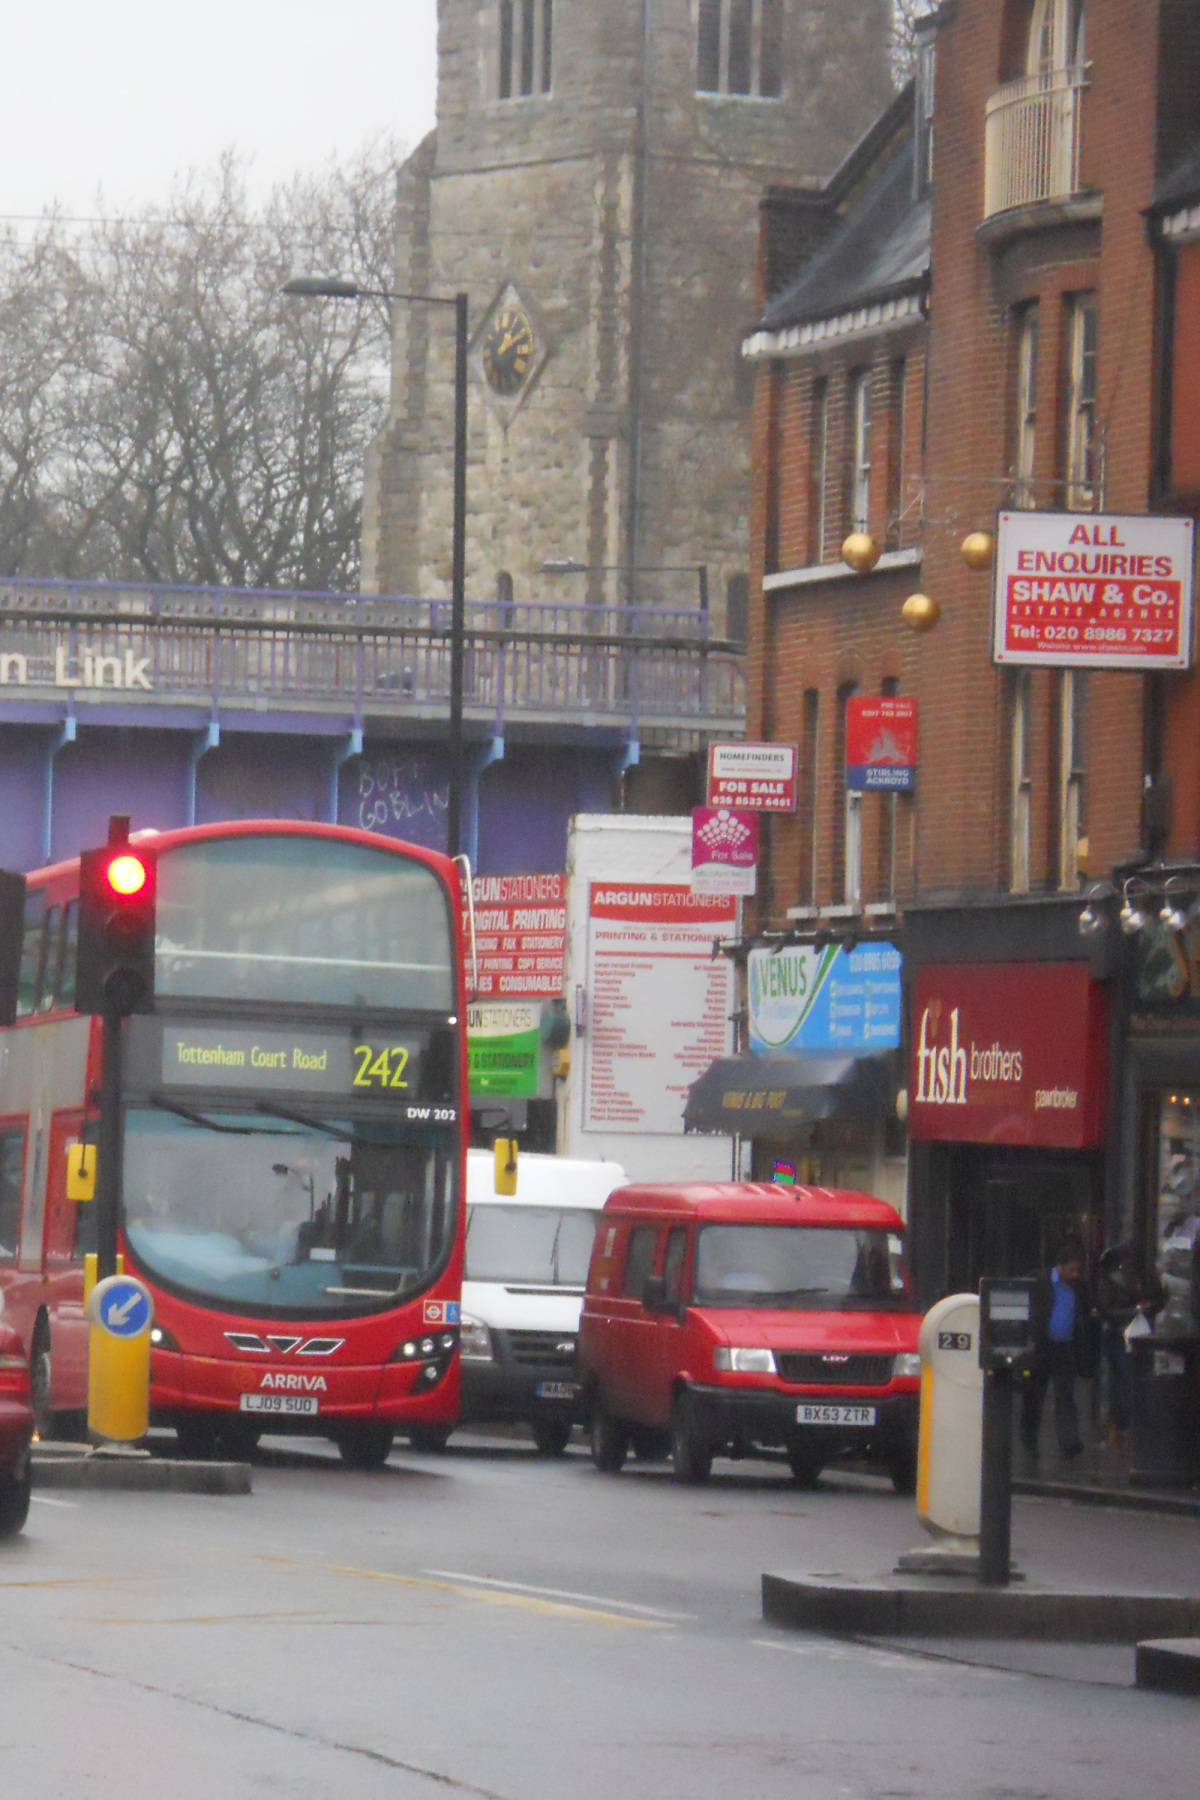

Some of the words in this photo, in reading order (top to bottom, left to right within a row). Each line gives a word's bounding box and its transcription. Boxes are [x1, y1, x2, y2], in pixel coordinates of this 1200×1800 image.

[1068, 524, 1125, 547] ALL
[1017, 550, 1174, 577] ENQUIRIES
[1013, 580, 1095, 603] SHAW
[1102, 584, 1124, 604] &
[1132, 585, 1175, 606] Co.
[1011, 625, 1040, 638] Tel:
[1044, 627, 1079, 640] 020
[1132, 629, 1175, 643] 7327
[55, 646, 153, 690] Link
[719, 752, 785, 762] HOMEFINDERS
[719, 781, 747, 793] FOR
[750, 782, 784, 794] SALE
[711, 851, 728, 860] For
[731, 851, 753, 860] Sale
[513, 909, 566, 930] PRINTING
[595, 931, 647, 940] PRINTING
[661, 933, 729, 942] STATIONERY
[500, 975, 562, 991] CONSUMABLES
[760, 955, 807, 996] VENUS
[468, 1009, 531, 1028] UNSTATIONERS
[177, 1042, 244, 1066] Tottenham
[251, 1046, 286, 1068] Court
[292, 1048, 326, 1070] Road
[353, 1046, 409, 1088] 242
[915, 1007, 967, 1104] fish
[971, 1041, 1022, 1081] brothers
[1035, 1086, 1078, 1110] pawnbroker
[407, 1108, 430, 1119] DW
[434, 1109, 456, 1121] 202
[260, 1373, 328, 1391] ARRIVA
[803, 1407, 839, 1421] BX53
[843, 1408, 870, 1422] ZTR
